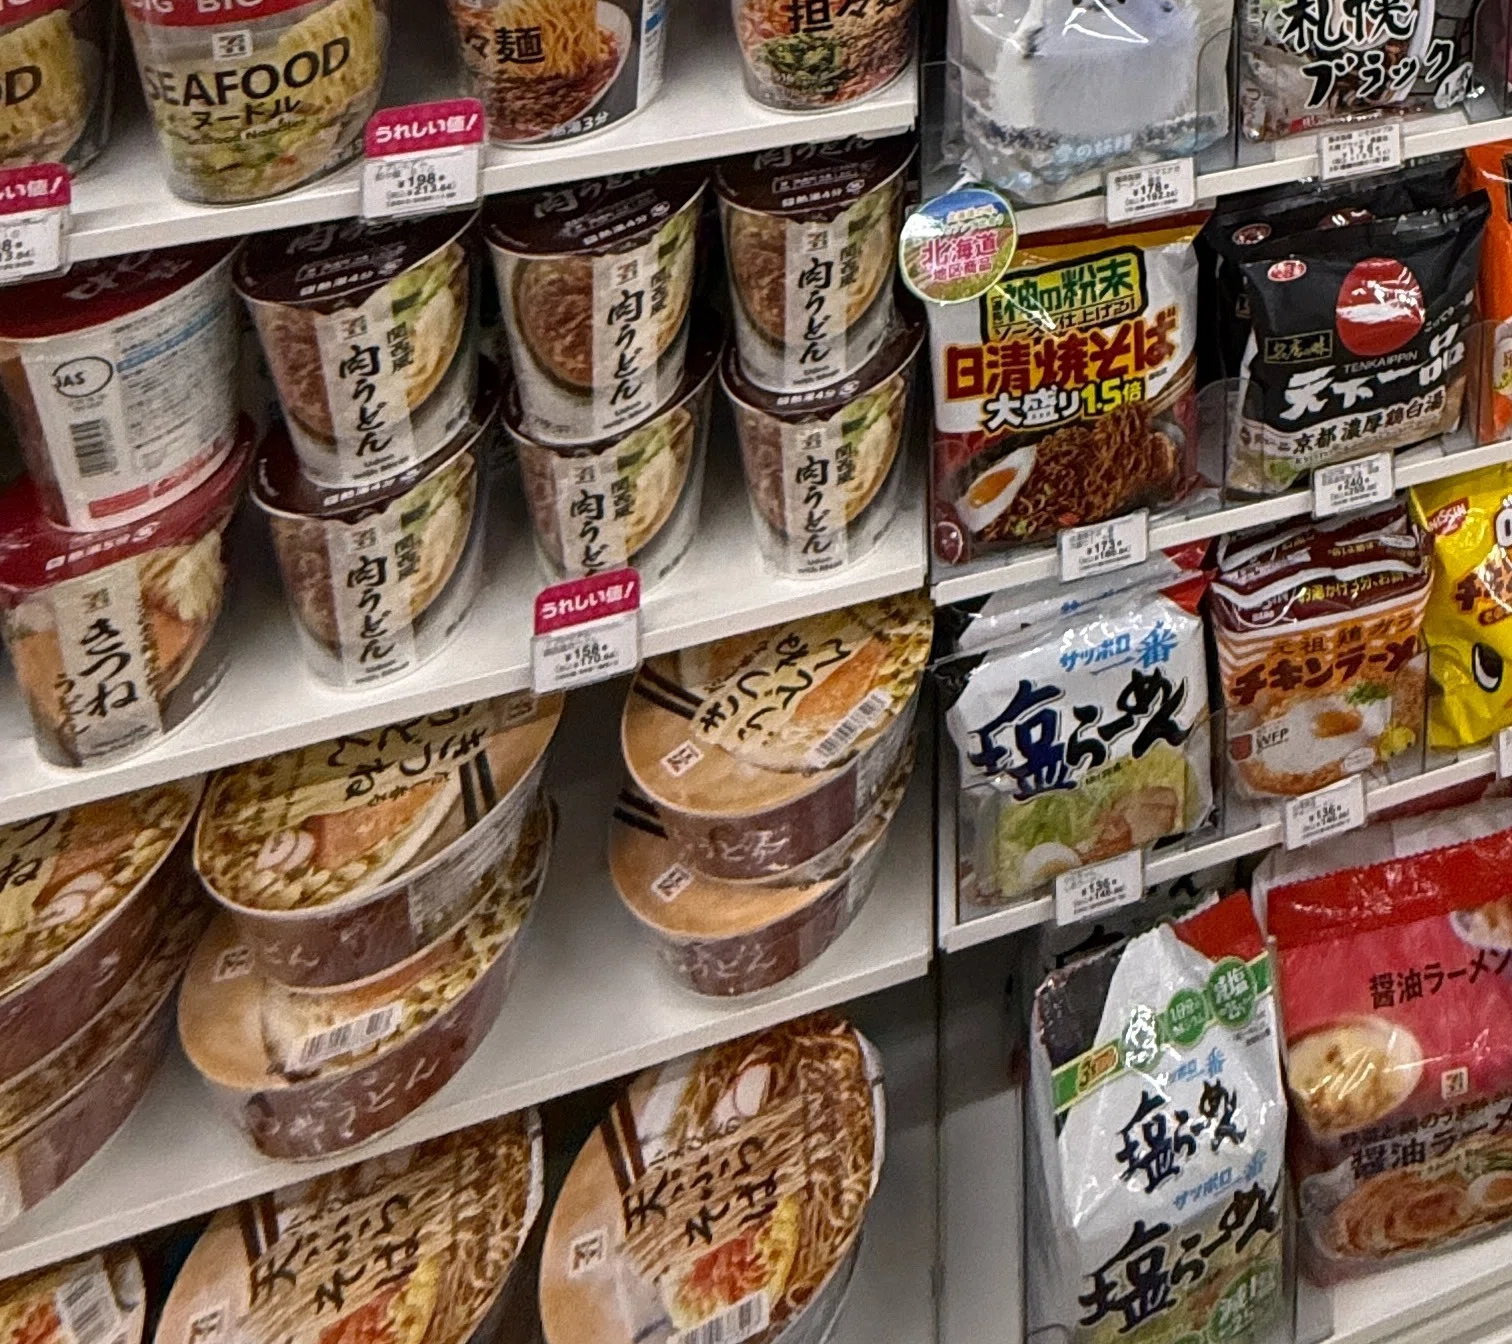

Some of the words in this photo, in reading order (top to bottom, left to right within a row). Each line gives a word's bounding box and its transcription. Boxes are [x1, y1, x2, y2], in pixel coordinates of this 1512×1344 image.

[144, 35, 351, 108] SEAFOOD
[1301, 38, 1456, 110] ブラック
[920, 230, 1000, 266] 北海道
[606, 288, 648, 408] 肉うどん
[797, 256, 833, 365] 肉うどん
[946, 305, 1179, 402] 日清焼そば
[337, 342, 393, 460] 肉うどん
[985, 376, 1145, 431] 大盛り1.5倍
[1279, 321, 1466, 421] 天下一品
[1343, 350, 1419, 375] TENKAIPPIN
[795, 453, 832, 556] 肉うどん
[347, 555, 396, 665] 肉うどん
[1058, 621, 1179, 675] サッポロ一番
[79, 617, 141, 719] きつね
[966, 664, 1195, 804] 塩らーめん
[1255, 726, 1291, 746] WFP
[1115, 1078, 1250, 1194] 塩らーめん
[1078, 1183, 1281, 1332] 塩らーめん
